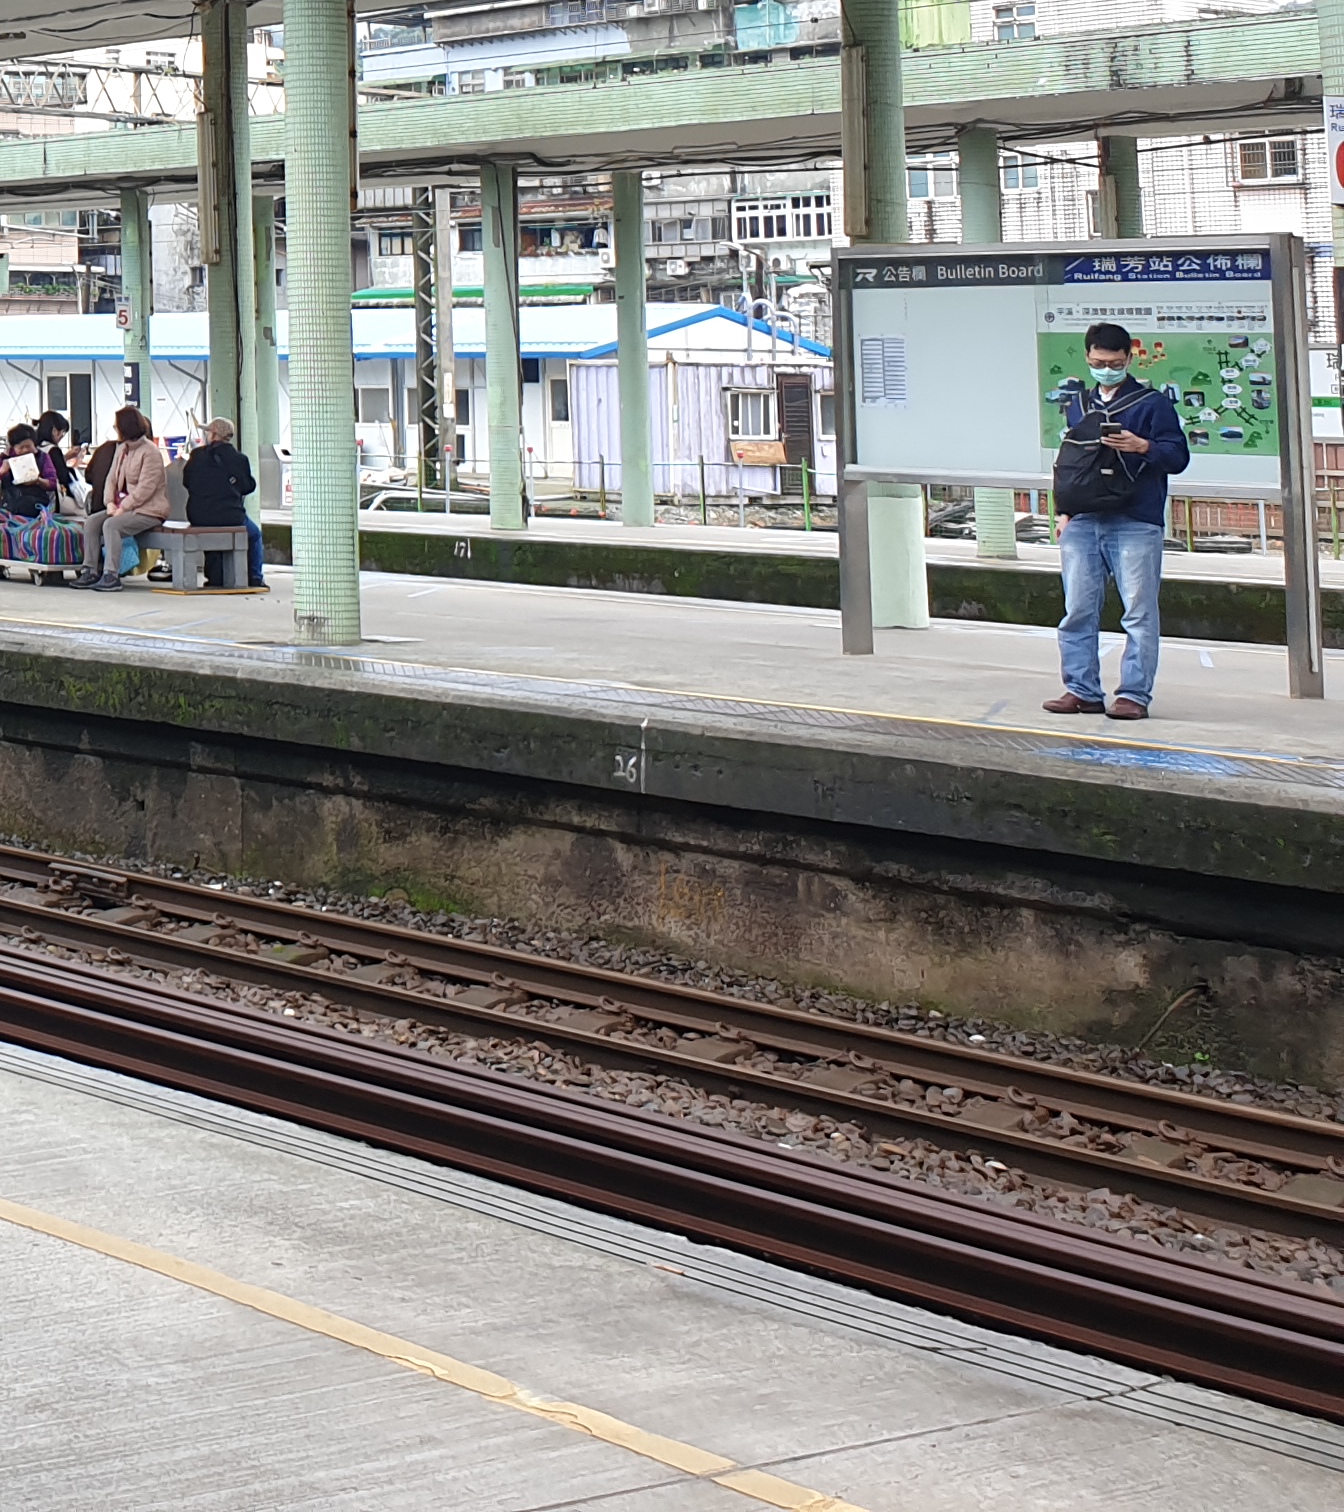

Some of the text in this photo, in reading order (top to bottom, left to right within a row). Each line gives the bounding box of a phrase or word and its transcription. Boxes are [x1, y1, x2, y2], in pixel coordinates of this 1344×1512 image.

[1092, 253, 1262, 272] 瑞芳站公佈欄
[882, 265, 927, 282] 公告欄
[937, 263, 1044, 280] Bulletin Board
[1073, 272, 1122, 281] Ruifang
[1128, 271, 1171, 279] Station
[1225, 270, 1261, 278] Board
[118, 310, 128, 325] 5
[613, 755, 637, 783] 26
